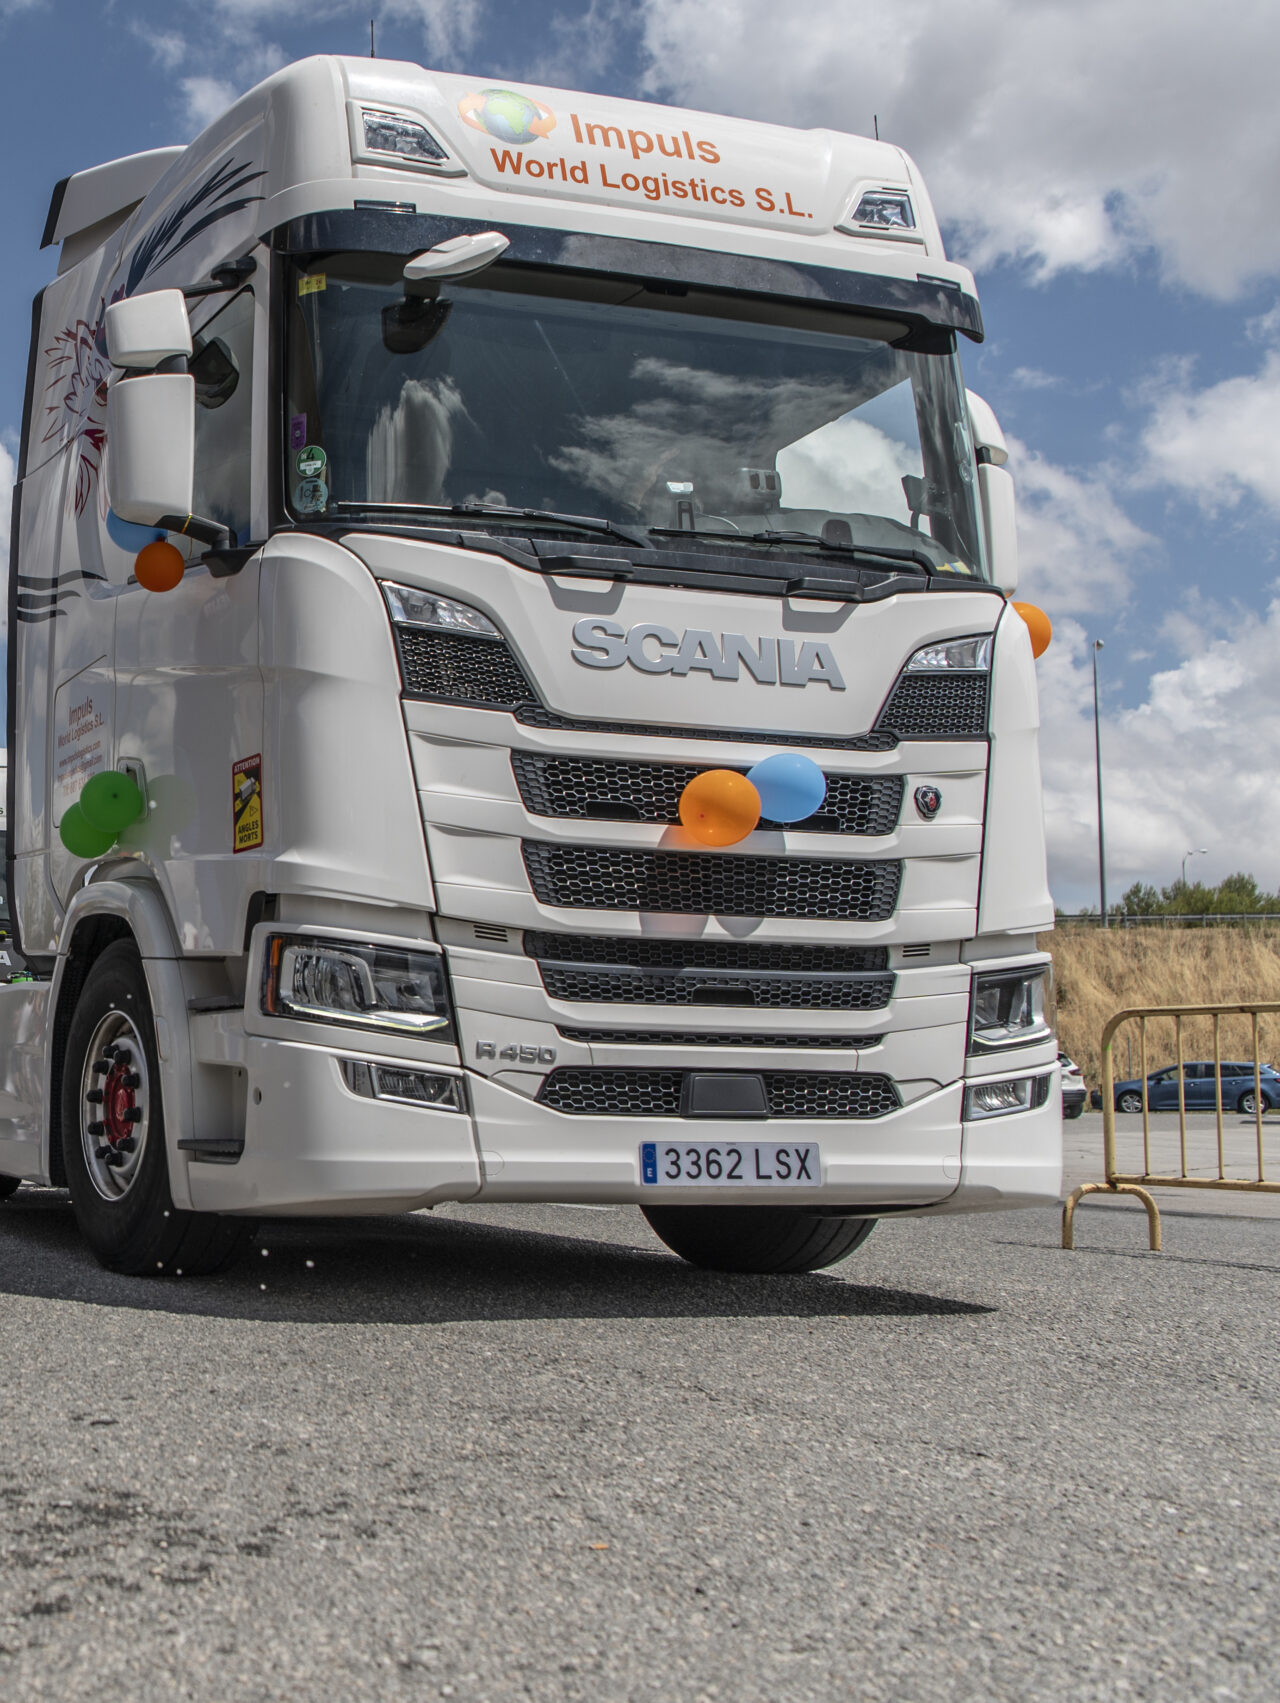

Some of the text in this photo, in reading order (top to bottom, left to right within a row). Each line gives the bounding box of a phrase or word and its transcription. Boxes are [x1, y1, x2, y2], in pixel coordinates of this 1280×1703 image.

[570, 113, 721, 164] Impuls
[490, 148, 814, 219] World Logistics S.L.
[571, 617, 846, 691] SCANIA
[68, 695, 93, 727] Impuls
[72, 720, 94, 742] Logistics
[238, 819, 259, 835] ANGLES
[238, 830, 259, 844] MORTS
[476, 1039, 557, 1065] R 450
[646, 1148, 812, 1180] E 3362 LSX
